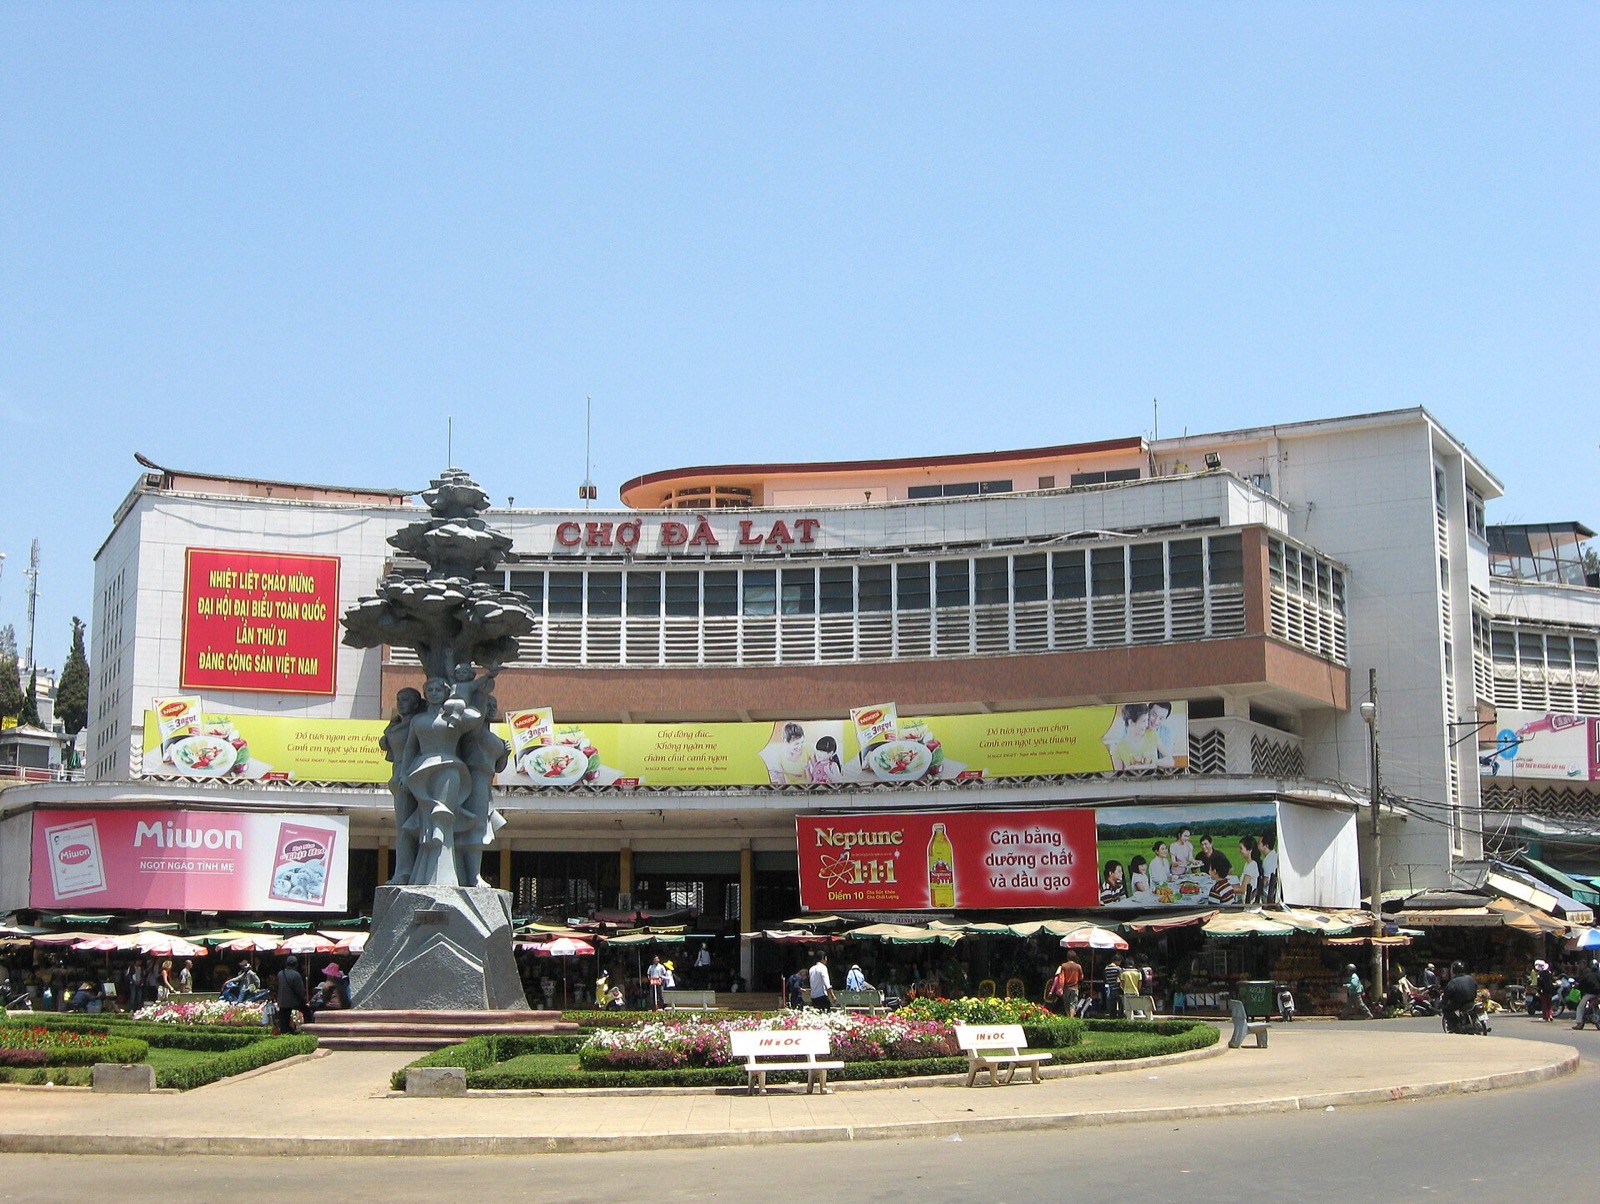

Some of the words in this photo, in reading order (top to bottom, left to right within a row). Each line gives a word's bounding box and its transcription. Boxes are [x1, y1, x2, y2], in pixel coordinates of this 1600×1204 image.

[556, 517, 642, 553] CHỢ
[660, 514, 719, 546] ĐÀ
[739, 518, 820, 550] LẠT
[209, 567, 238, 594] NHIỆT
[239, 568, 260, 595] LIỆT
[261, 569, 286, 592] CHÀO
[288, 571, 315, 594] MỪNG
[197, 596, 214, 620] ĐẠI
[216, 594, 232, 621] HỘI
[234, 598, 250, 622] ĐẠI
[251, 592, 273, 619] BIỂU
[275, 597, 299, 620] TOÀN
[301, 596, 327, 621] QUỐC
[236, 619, 255, 645] LẦN
[256, 623, 277, 646] THỨ
[277, 629, 287, 647] XI
[198, 645, 225, 670] ĐẢNG
[226, 649, 252, 676] CỘNG
[254, 648, 273, 673] SẢN
[275, 652, 296, 679] VIỆT
[297, 657, 318, 676] NAM
[326, 734, 346, 743] ngon
[361, 733, 380, 743] chọn
[658, 729, 674, 739] Chợ
[1016, 727, 1036, 736] ngon
[1050, 722, 1069, 733] chọn
[287, 743, 308, 751] Canh
[323, 745, 341, 755] ngọt
[655, 741, 682, 752] Không
[705, 743, 718, 751] mẹ
[980, 738, 999, 748] Canh
[1014, 738, 1031, 748] ngọt
[687, 752, 707, 761] canh
[708, 755, 728, 764] ngon
[134, 820, 243, 849] Miwon
[814, 827, 903, 850] Neptune
[990, 830, 1020, 844] Cân
[1024, 827, 1062, 847] bằng
[60, 848, 90, 861] Miwon
[985, 852, 1036, 869] dưỡng
[1041, 848, 1073, 865] chất
[140, 861, 167, 872] NGỌT
[167, 859, 195, 870] NGÀO
[197, 861, 218, 871] TÌNH
[220, 863, 235, 872] MẸ
[852, 860, 897, 884] 1:1:1
[989, 873, 1006, 887] và
[1011, 871, 1038, 887] dầu
[1043, 876, 1071, 891] gạo
[828, 890, 851, 900] Điểm
[854, 892, 864, 900] 10
